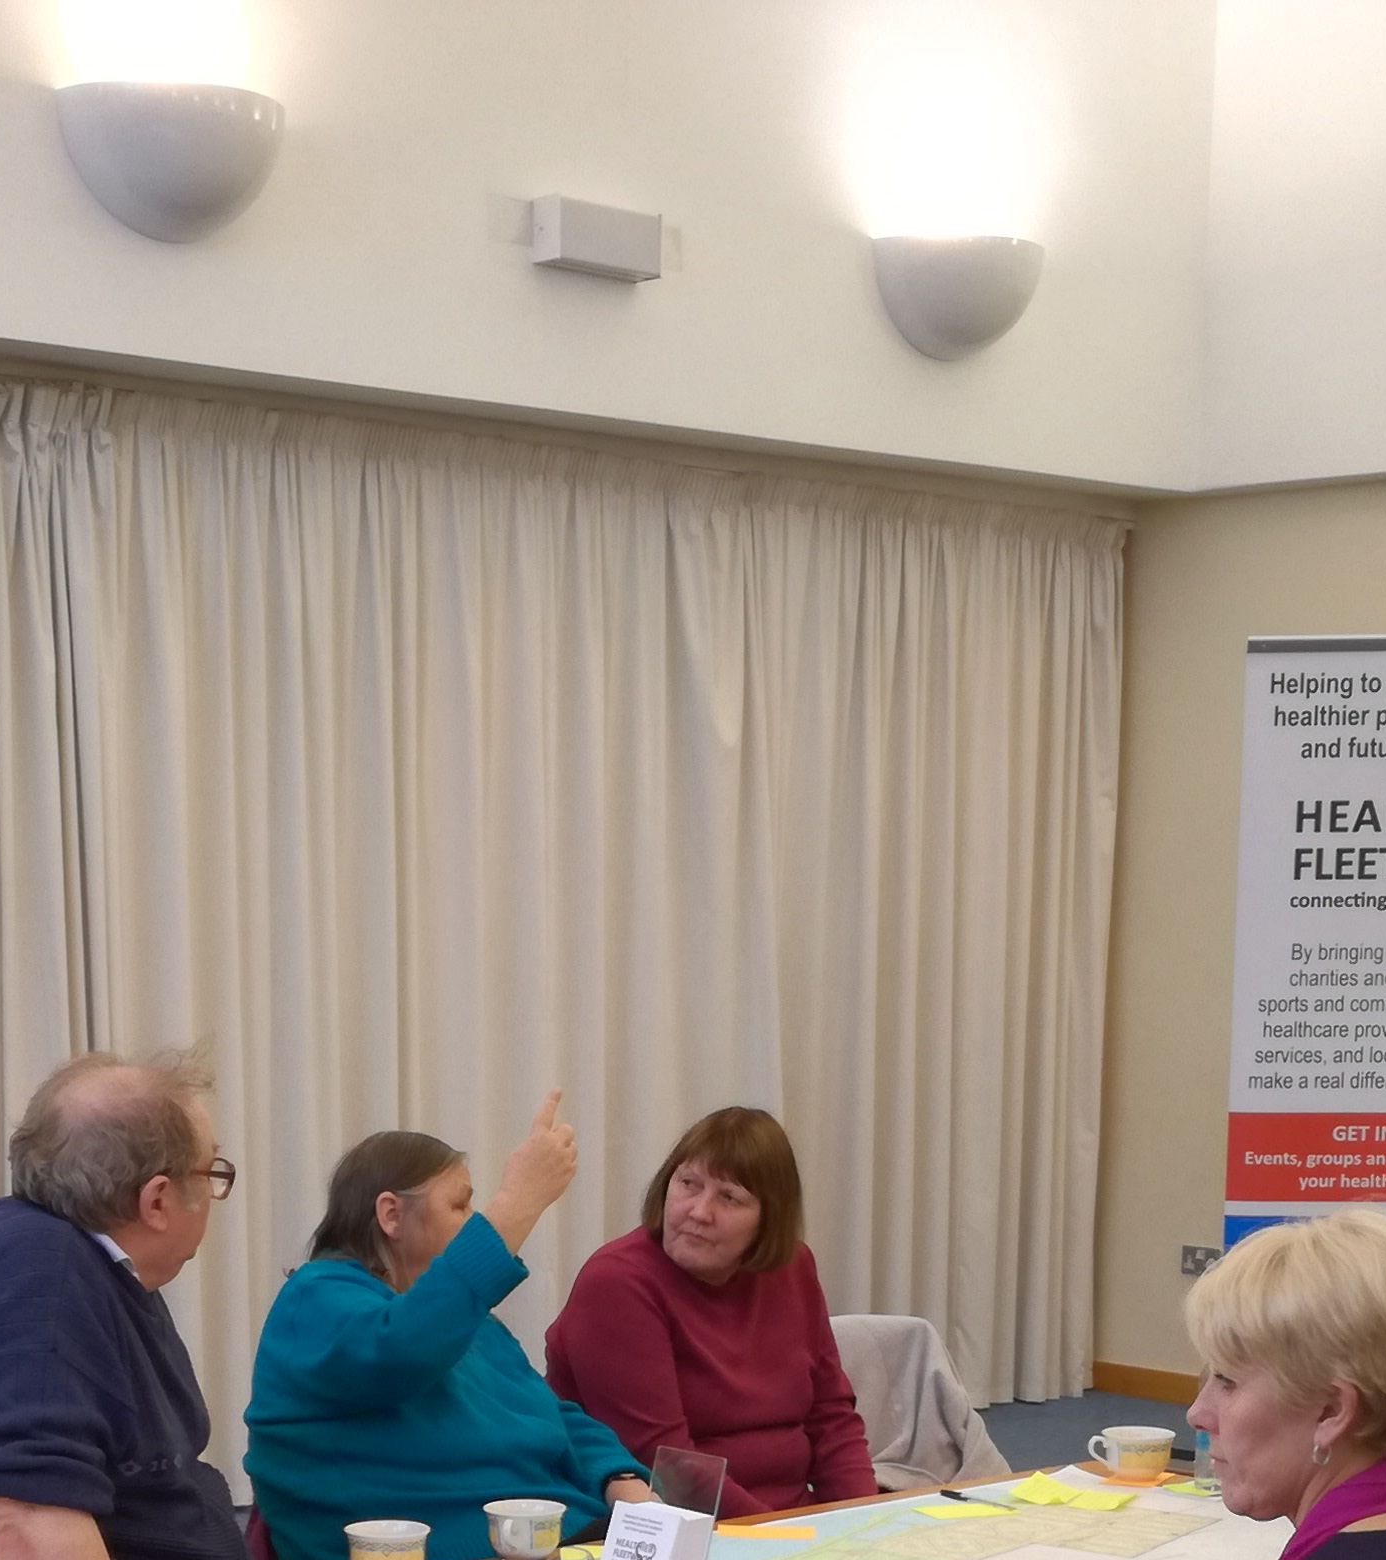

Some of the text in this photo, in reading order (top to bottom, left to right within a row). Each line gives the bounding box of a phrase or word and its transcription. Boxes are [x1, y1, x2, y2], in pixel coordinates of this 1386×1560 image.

[1270, 672, 1353, 698] Helping
[1361, 673, 1382, 693] to
[1274, 705, 1370, 726] healthier
[1301, 739, 1341, 758] and
[1291, 944, 1312, 964] By
[1318, 943, 1384, 964] bringing
[1290, 970, 1358, 986] charities
[1258, 996, 1308, 1015] sports
[1314, 996, 1344, 1012] and
[1263, 1022, 1349, 1037] healthcare
[1255, 1048, 1327, 1066] services,
[1333, 1047, 1363, 1063] and
[1248, 1073, 1293, 1089] make
[1299, 1076, 1308, 1089] a
[1315, 1073, 1345, 1089] real
[1332, 1126, 1368, 1142] GET
[1245, 1151, 1302, 1168] Events,
[1306, 1153, 1361, 1168] groups
[1299, 1177, 1335, 1190] your
